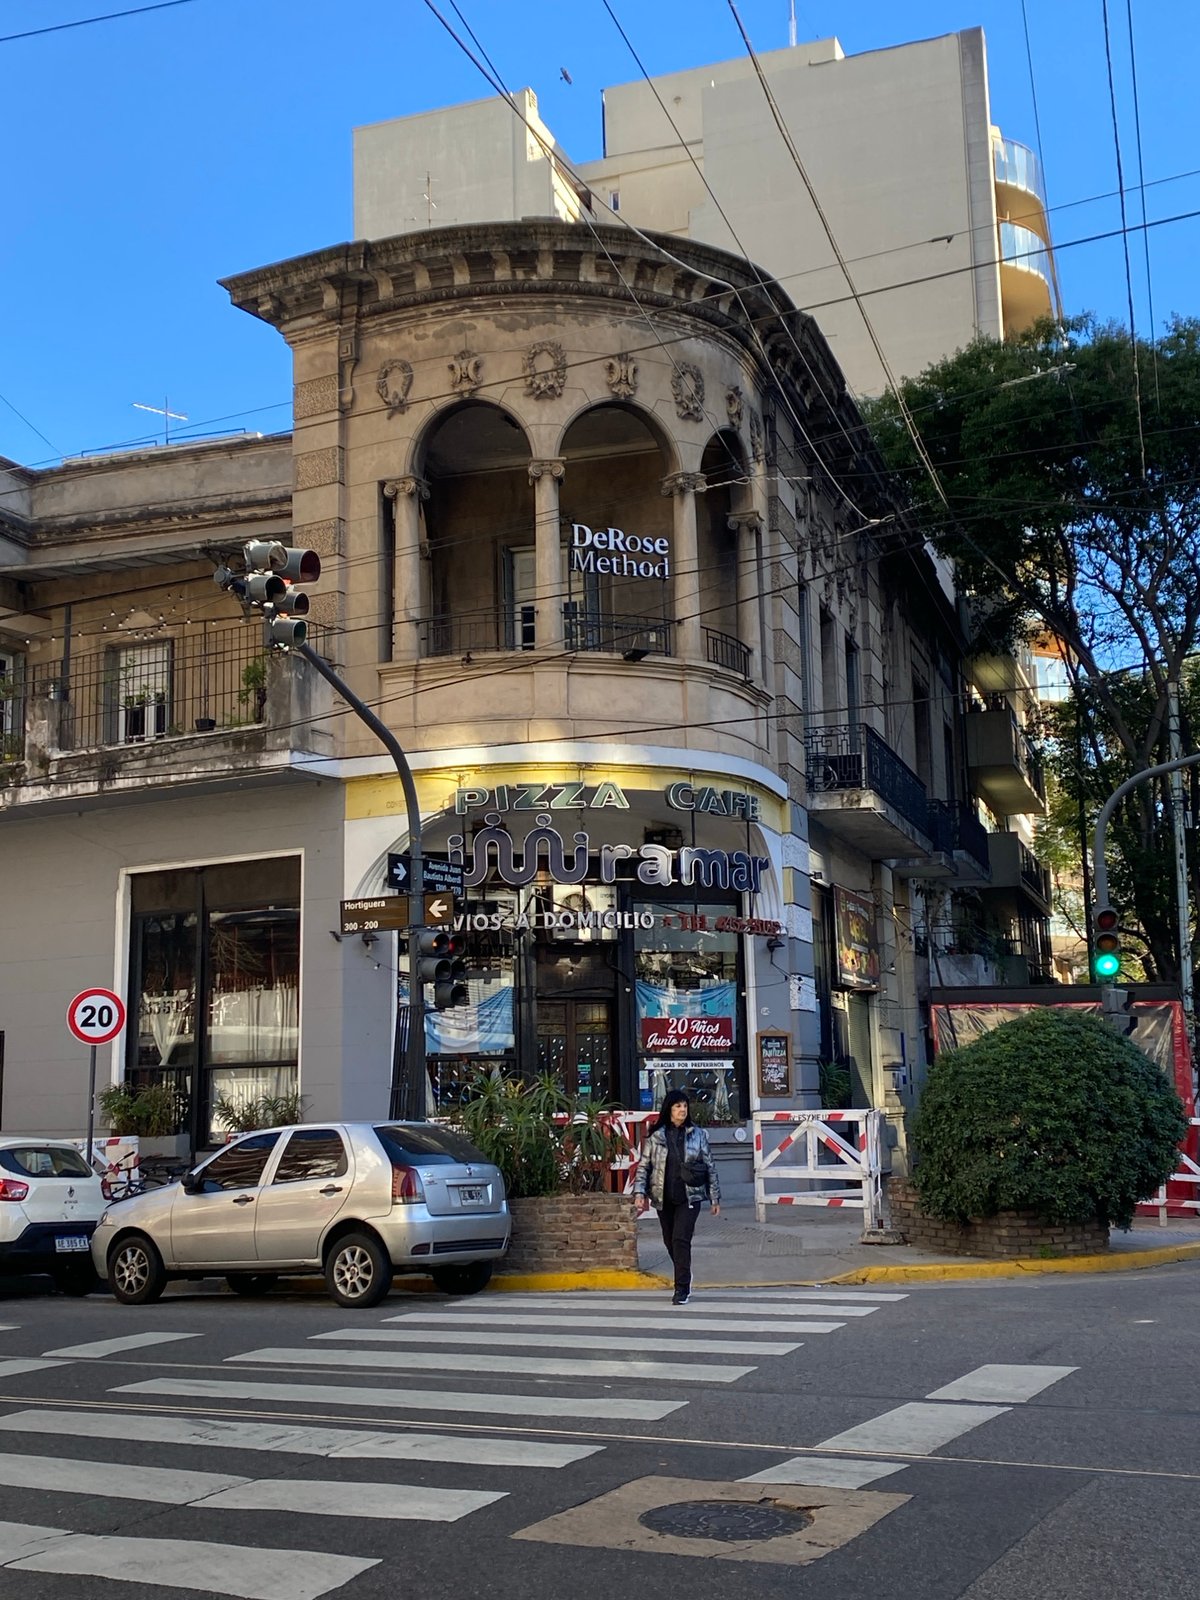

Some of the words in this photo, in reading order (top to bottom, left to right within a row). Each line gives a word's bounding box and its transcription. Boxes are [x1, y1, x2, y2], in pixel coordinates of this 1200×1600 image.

[572, 523, 669, 555] DeRose
[571, 549, 670, 579] Method
[455, 781, 631, 815] PIZZA
[665, 782, 763, 822] CAFE
[428, 861, 449, 872] Avenida
[449, 865, 462, 874] Juan
[423, 870, 444, 881] Bautista
[444, 874, 462, 884] Alberdi
[344, 900, 386, 910] Hortiguera
[344, 922, 358, 931] 300
[365, 921, 379, 930] 200
[516, 913, 530, 930] A
[544, 911, 655, 930] DOMICILIO
[80, 1005, 113, 1028] 20
[667, 1017, 689, 1035] 20
[690, 1019, 720, 1034] Años
[646, 1032, 679, 1049] Junto
[680, 1037, 689, 1046] a
[689, 1034, 732, 1049] Ustedes
